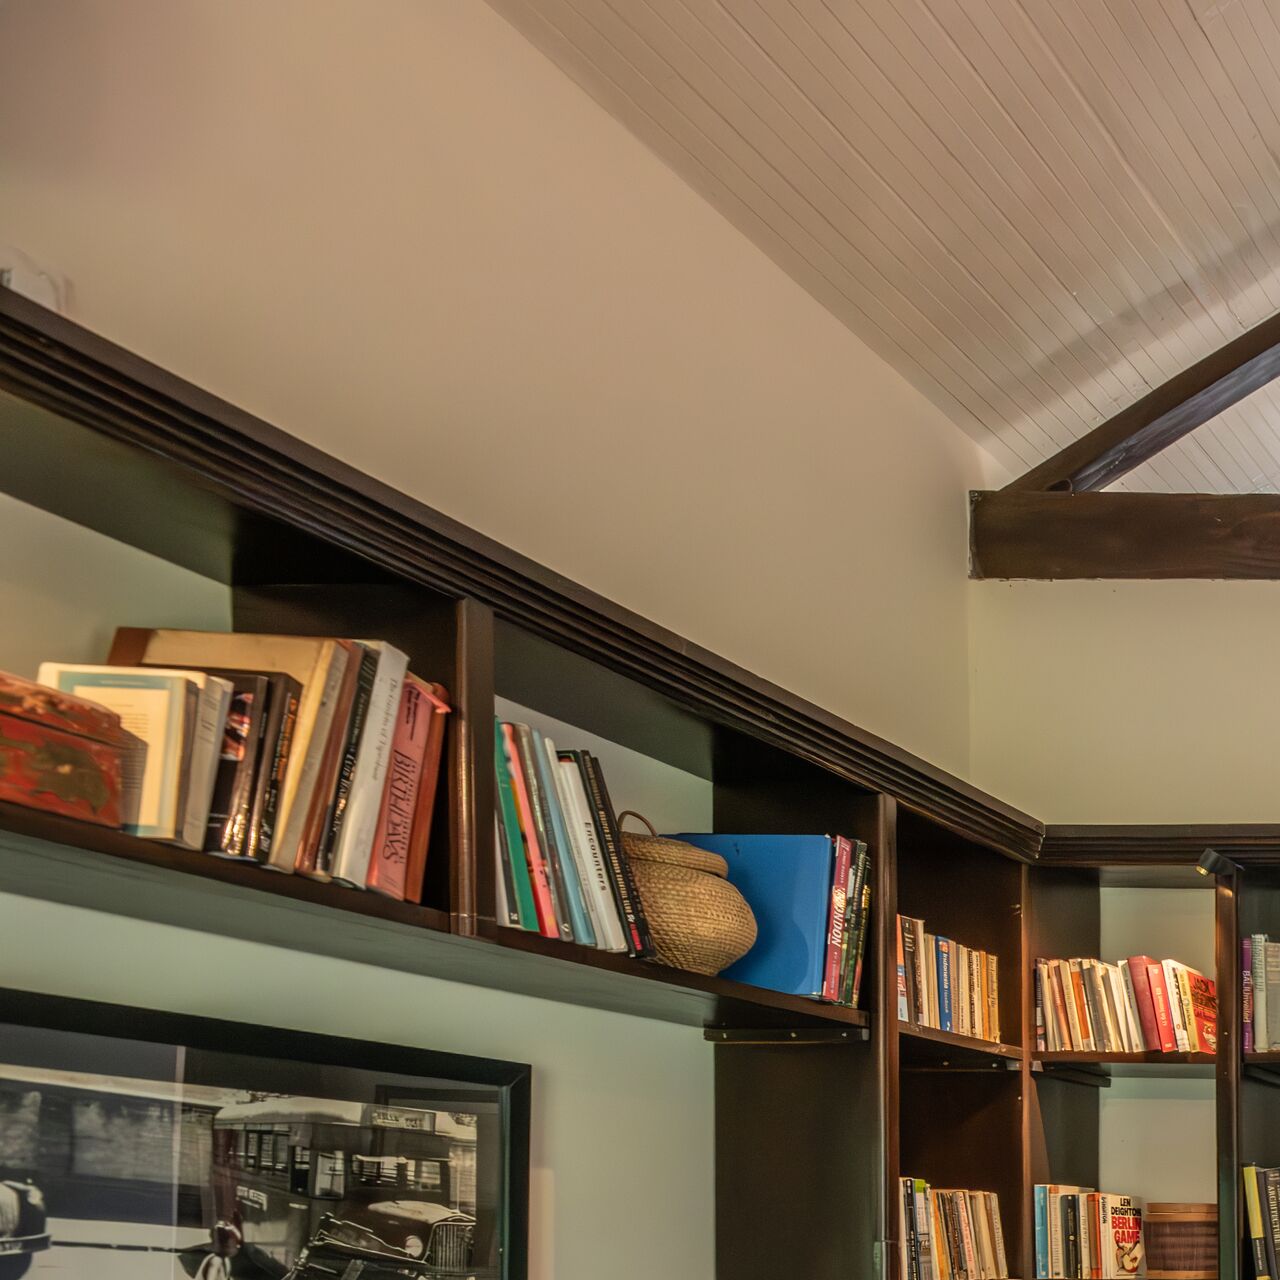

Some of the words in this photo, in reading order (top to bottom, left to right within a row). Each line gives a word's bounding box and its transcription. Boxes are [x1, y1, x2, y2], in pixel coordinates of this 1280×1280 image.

[383, 748, 417, 864] BIRTHDAYS
[584, 821, 607, 892] Encounters
[939, 953, 952, 989] Indonesia
[1120, 1197, 1131, 1207] LEN
[1110, 1206, 1142, 1217] DEIGHTON
[1111, 1216, 1142, 1230] BERLIN
[1114, 1229, 1141, 1244] GAME
